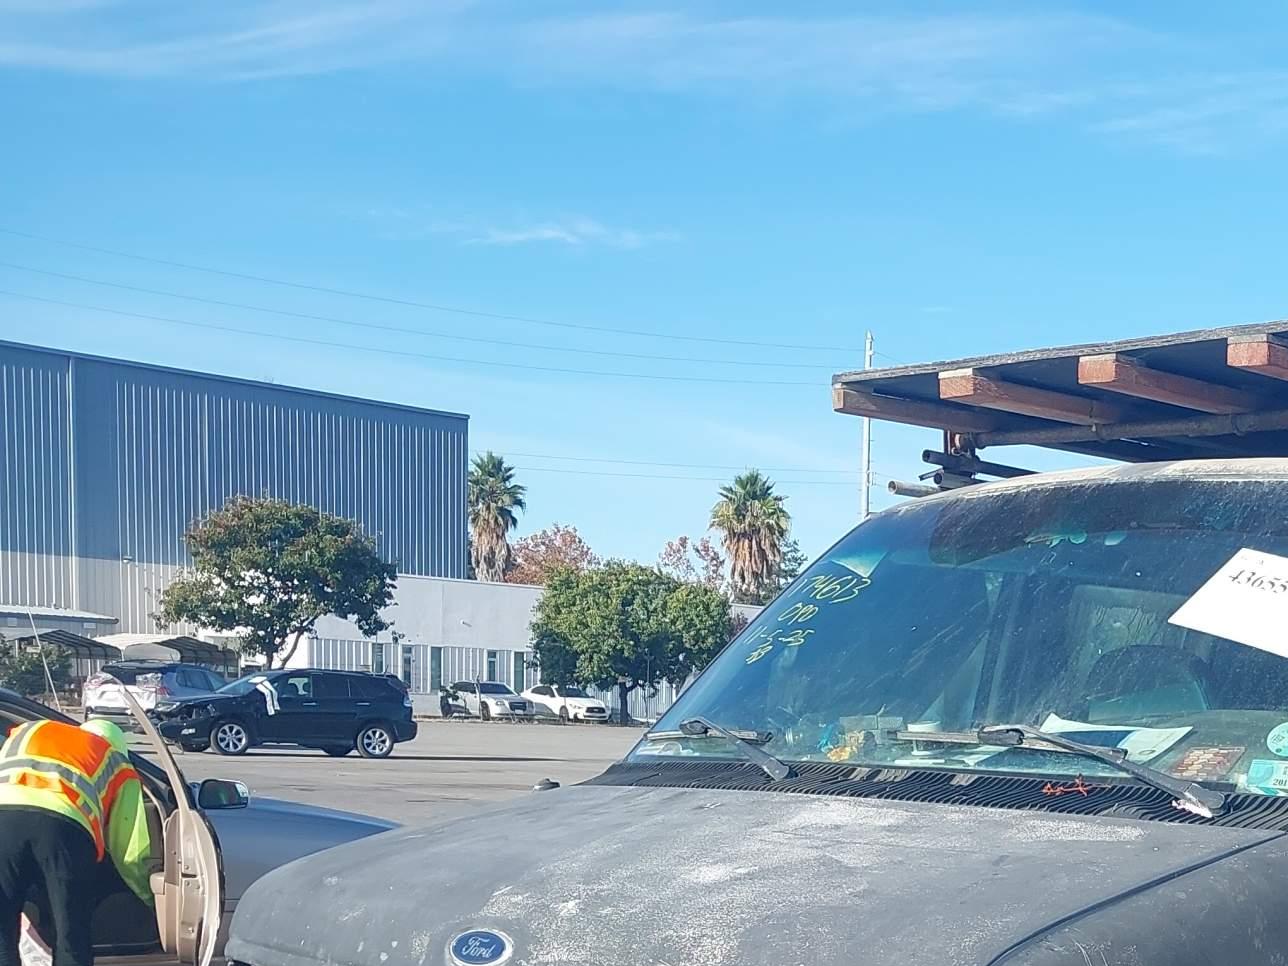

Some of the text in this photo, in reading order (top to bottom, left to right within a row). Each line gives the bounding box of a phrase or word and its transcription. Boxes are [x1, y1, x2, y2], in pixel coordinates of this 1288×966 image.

[788, 574, 872, 604] 174613
[743, 625, 815, 648] 11-5-25
[461, 936, 497, 958] Ford
